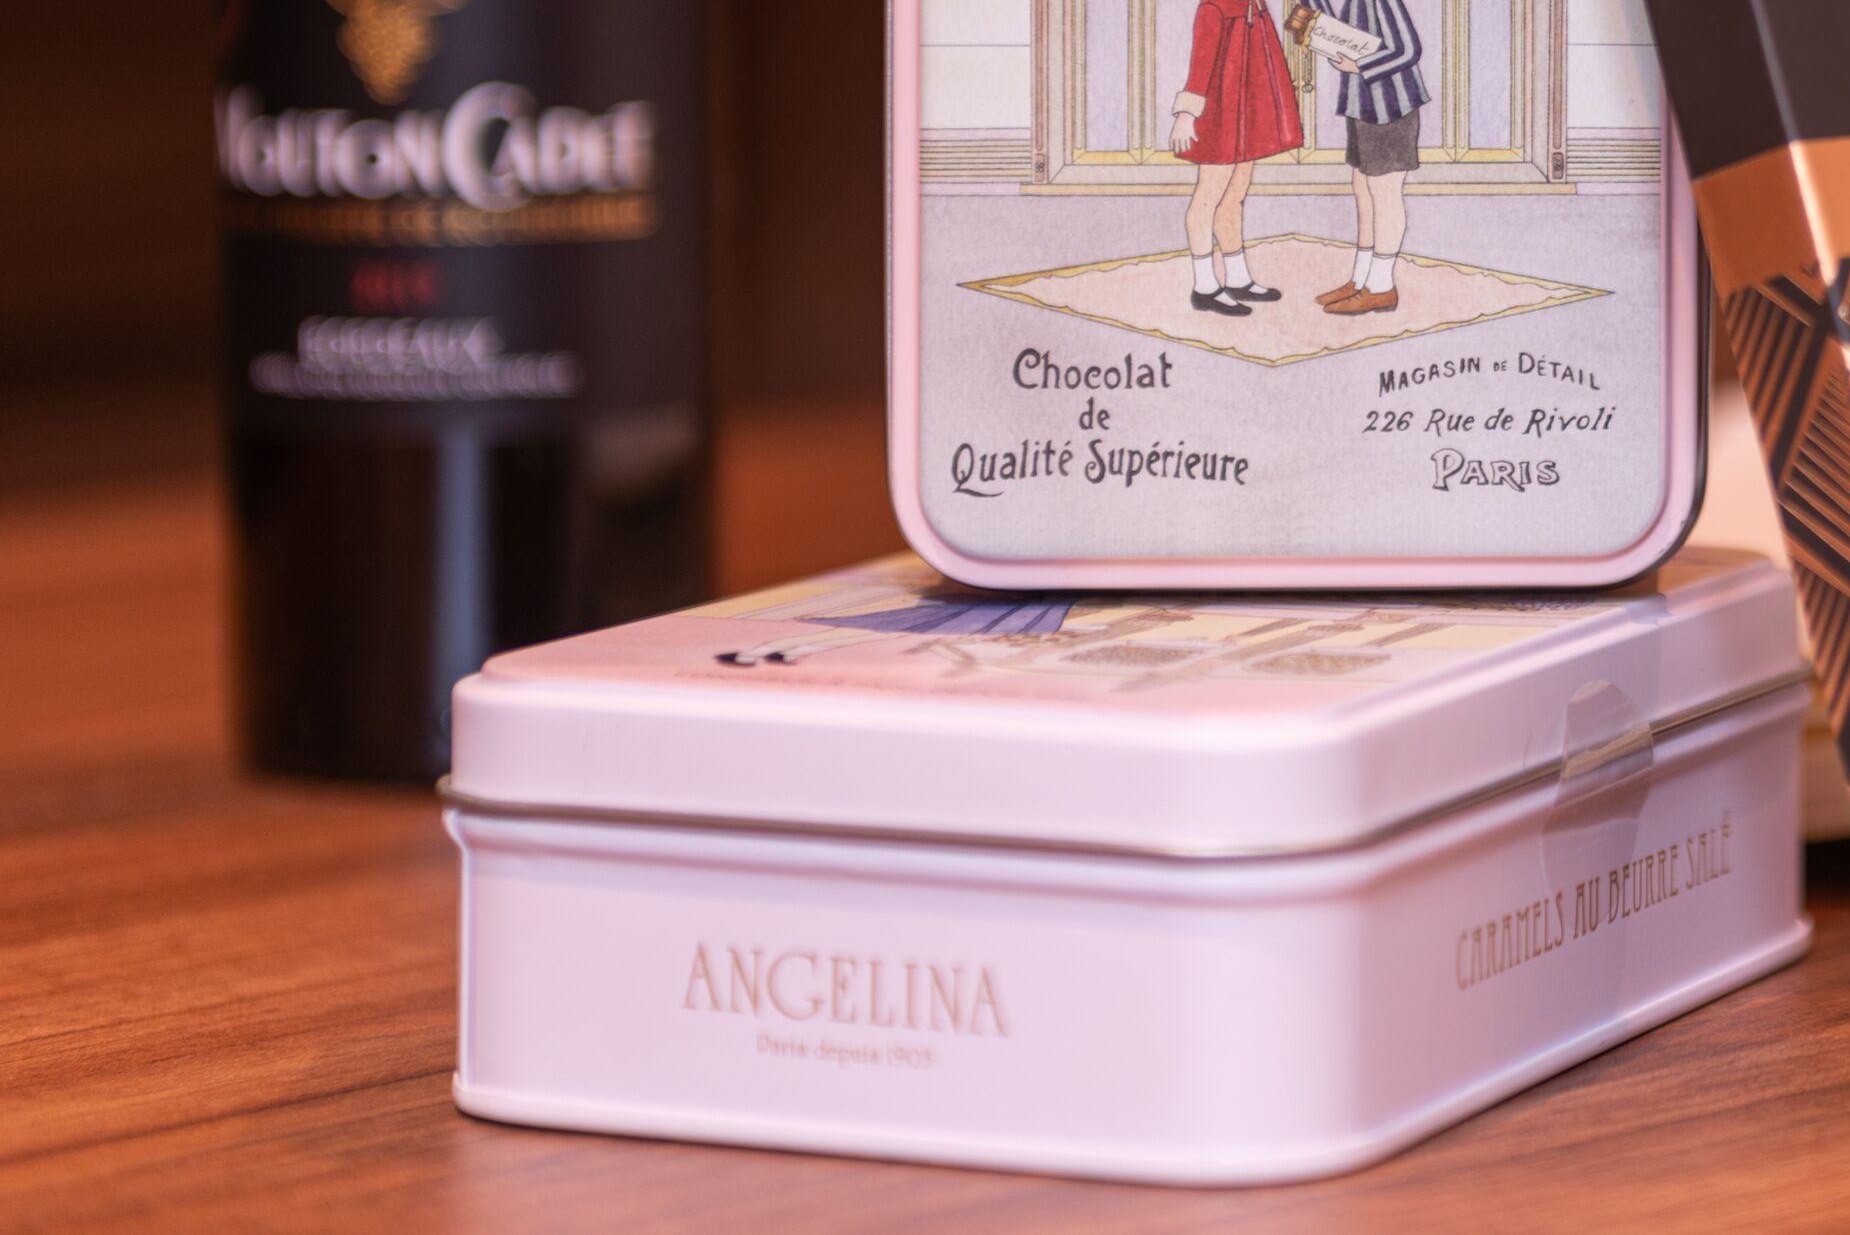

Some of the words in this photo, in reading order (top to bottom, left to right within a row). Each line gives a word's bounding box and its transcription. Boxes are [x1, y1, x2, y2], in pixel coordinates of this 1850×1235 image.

[1013, 348, 1172, 389] Chocolat
[1379, 357, 1480, 397] MAGASIN
[1493, 361, 1507, 372] DE
[1518, 352, 1600, 390] DÉTAIL
[1079, 397, 1110, 430] de
[1362, 411, 1413, 433] 226
[1424, 409, 1474, 437] Rue
[1484, 407, 1513, 431] de
[1523, 406, 1616, 438] Rivoli
[952, 439, 1073, 497] Qualité
[1085, 439, 1248, 487] Supérieure
[1431, 448, 1559, 492] PARIS
[1456, 888, 1564, 991] CARAMELS
[1573, 877, 1601, 939] AU
[1608, 844, 1678, 924] BEURRE
[682, 941, 1012, 1038] ANGELINA
[756, 1033, 808, 1057] Paris
